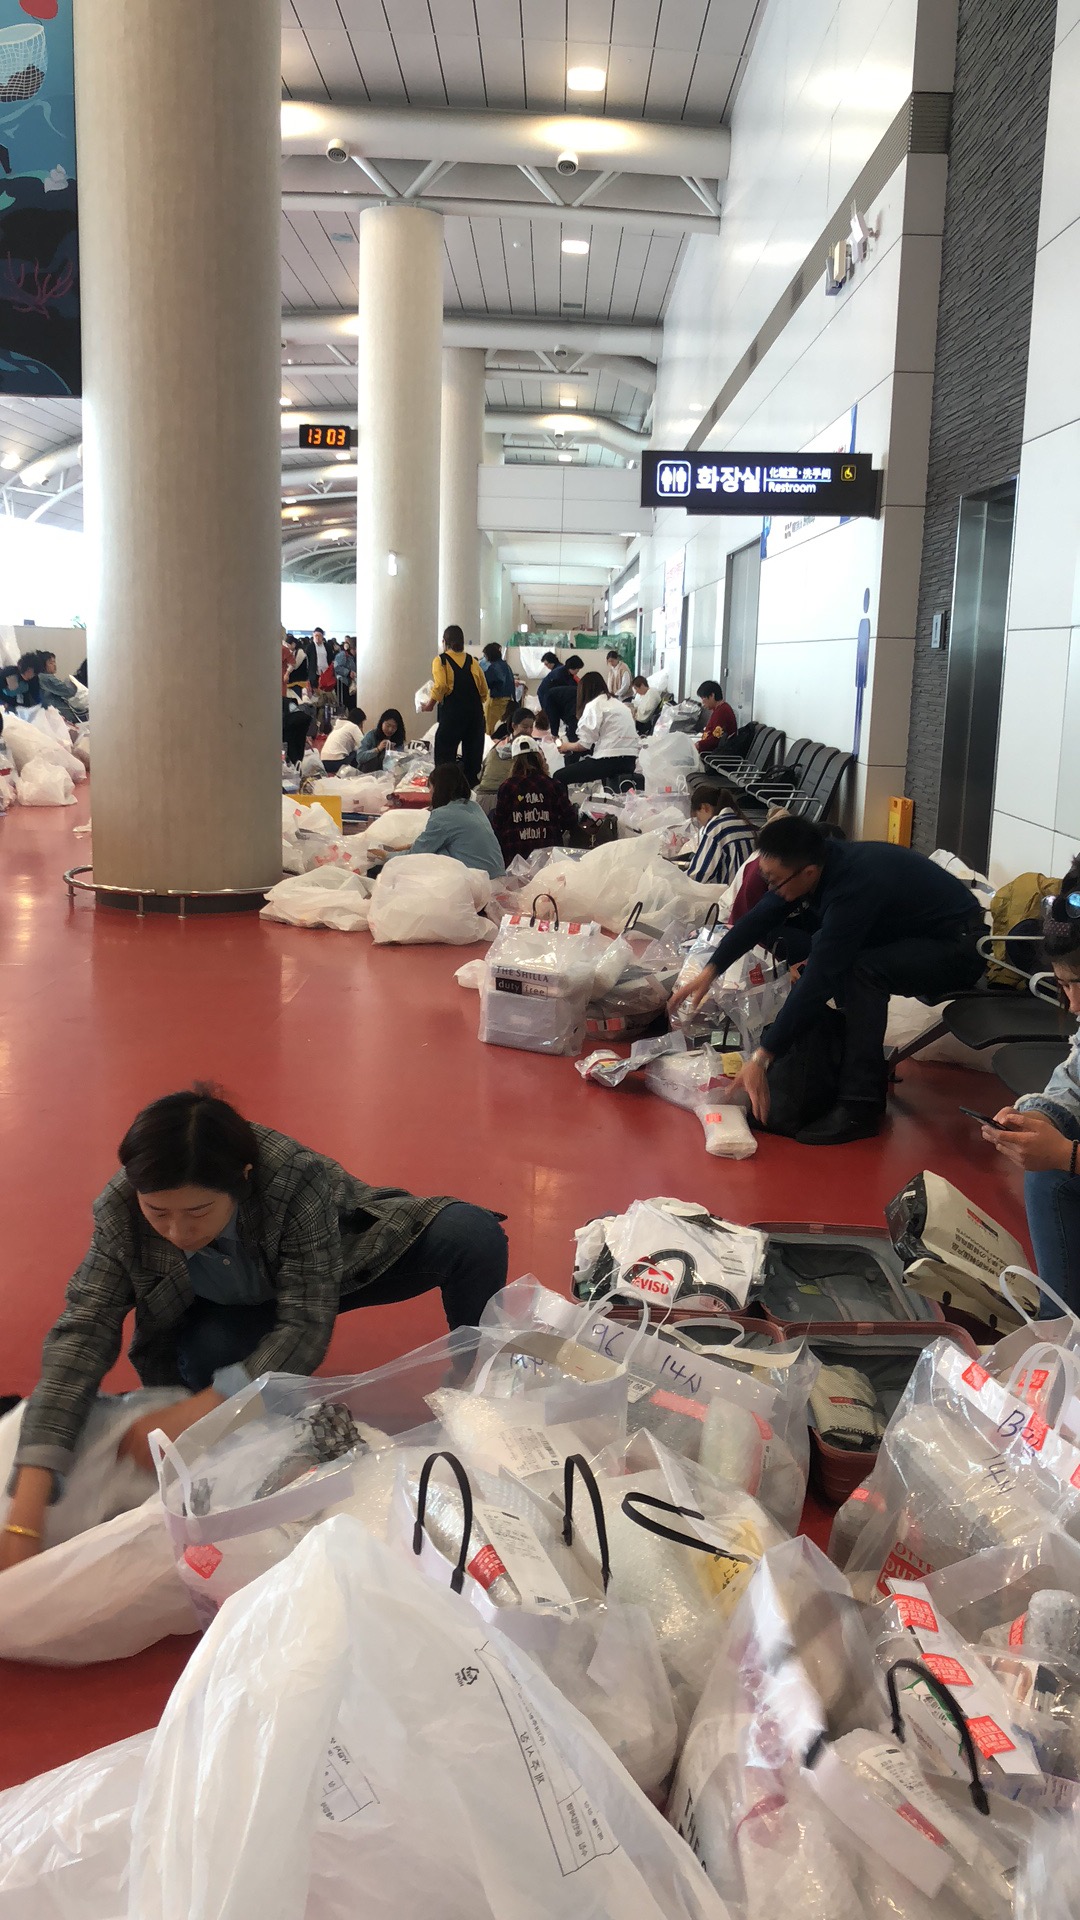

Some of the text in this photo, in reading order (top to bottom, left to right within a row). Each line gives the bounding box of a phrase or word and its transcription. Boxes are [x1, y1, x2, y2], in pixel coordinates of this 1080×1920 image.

[696, 465, 761, 493] 화장실
[768, 482, 817, 493] Restroom
[496, 965, 550, 983] THE SHILLA
[498, 980, 546, 997] duty free
[885, 1559, 921, 1581] DUT
